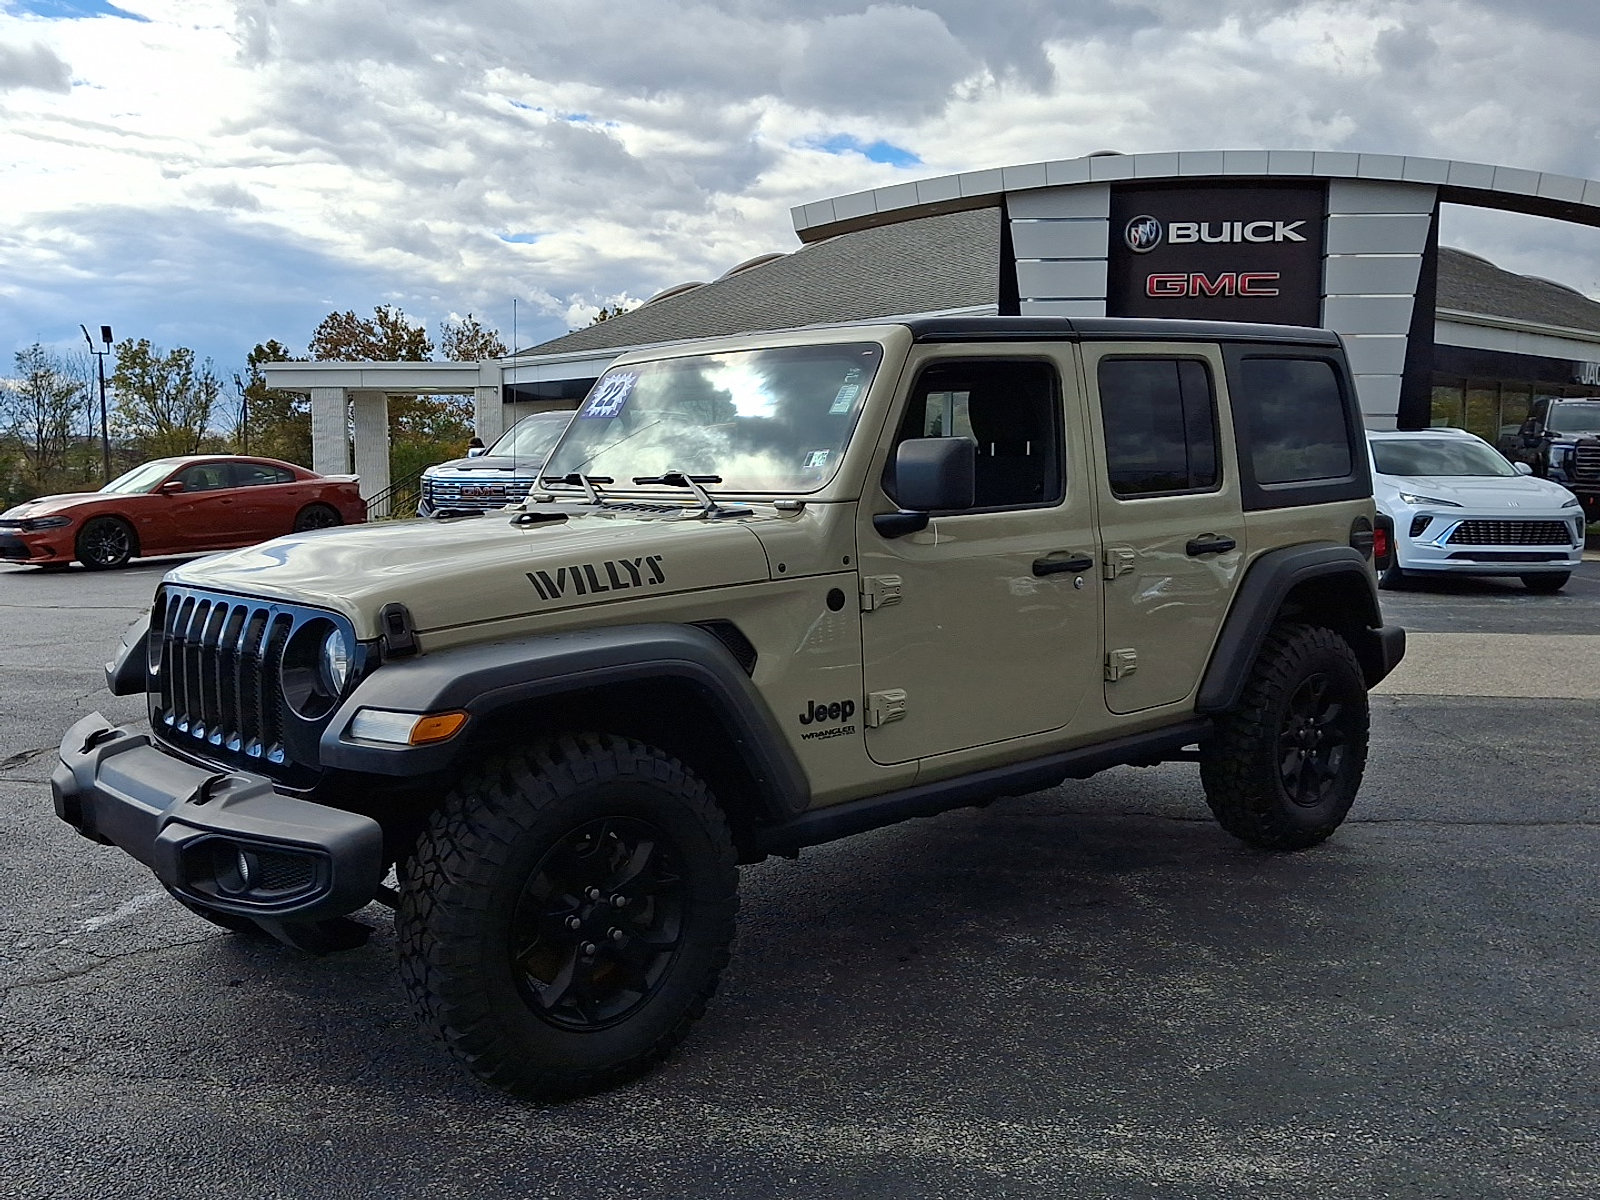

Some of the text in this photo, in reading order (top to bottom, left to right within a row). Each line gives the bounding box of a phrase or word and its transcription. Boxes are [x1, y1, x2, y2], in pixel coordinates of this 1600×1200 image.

[1168, 221, 1307, 244] BUICK
[1146, 272, 1280, 297] GMC
[594, 381, 626, 407] 22
[461, 486, 504, 496] GMC
[525, 555, 666, 600] WILLYS
[799, 700, 855, 725] Jeep
[801, 725, 856, 740] WRANGLER
